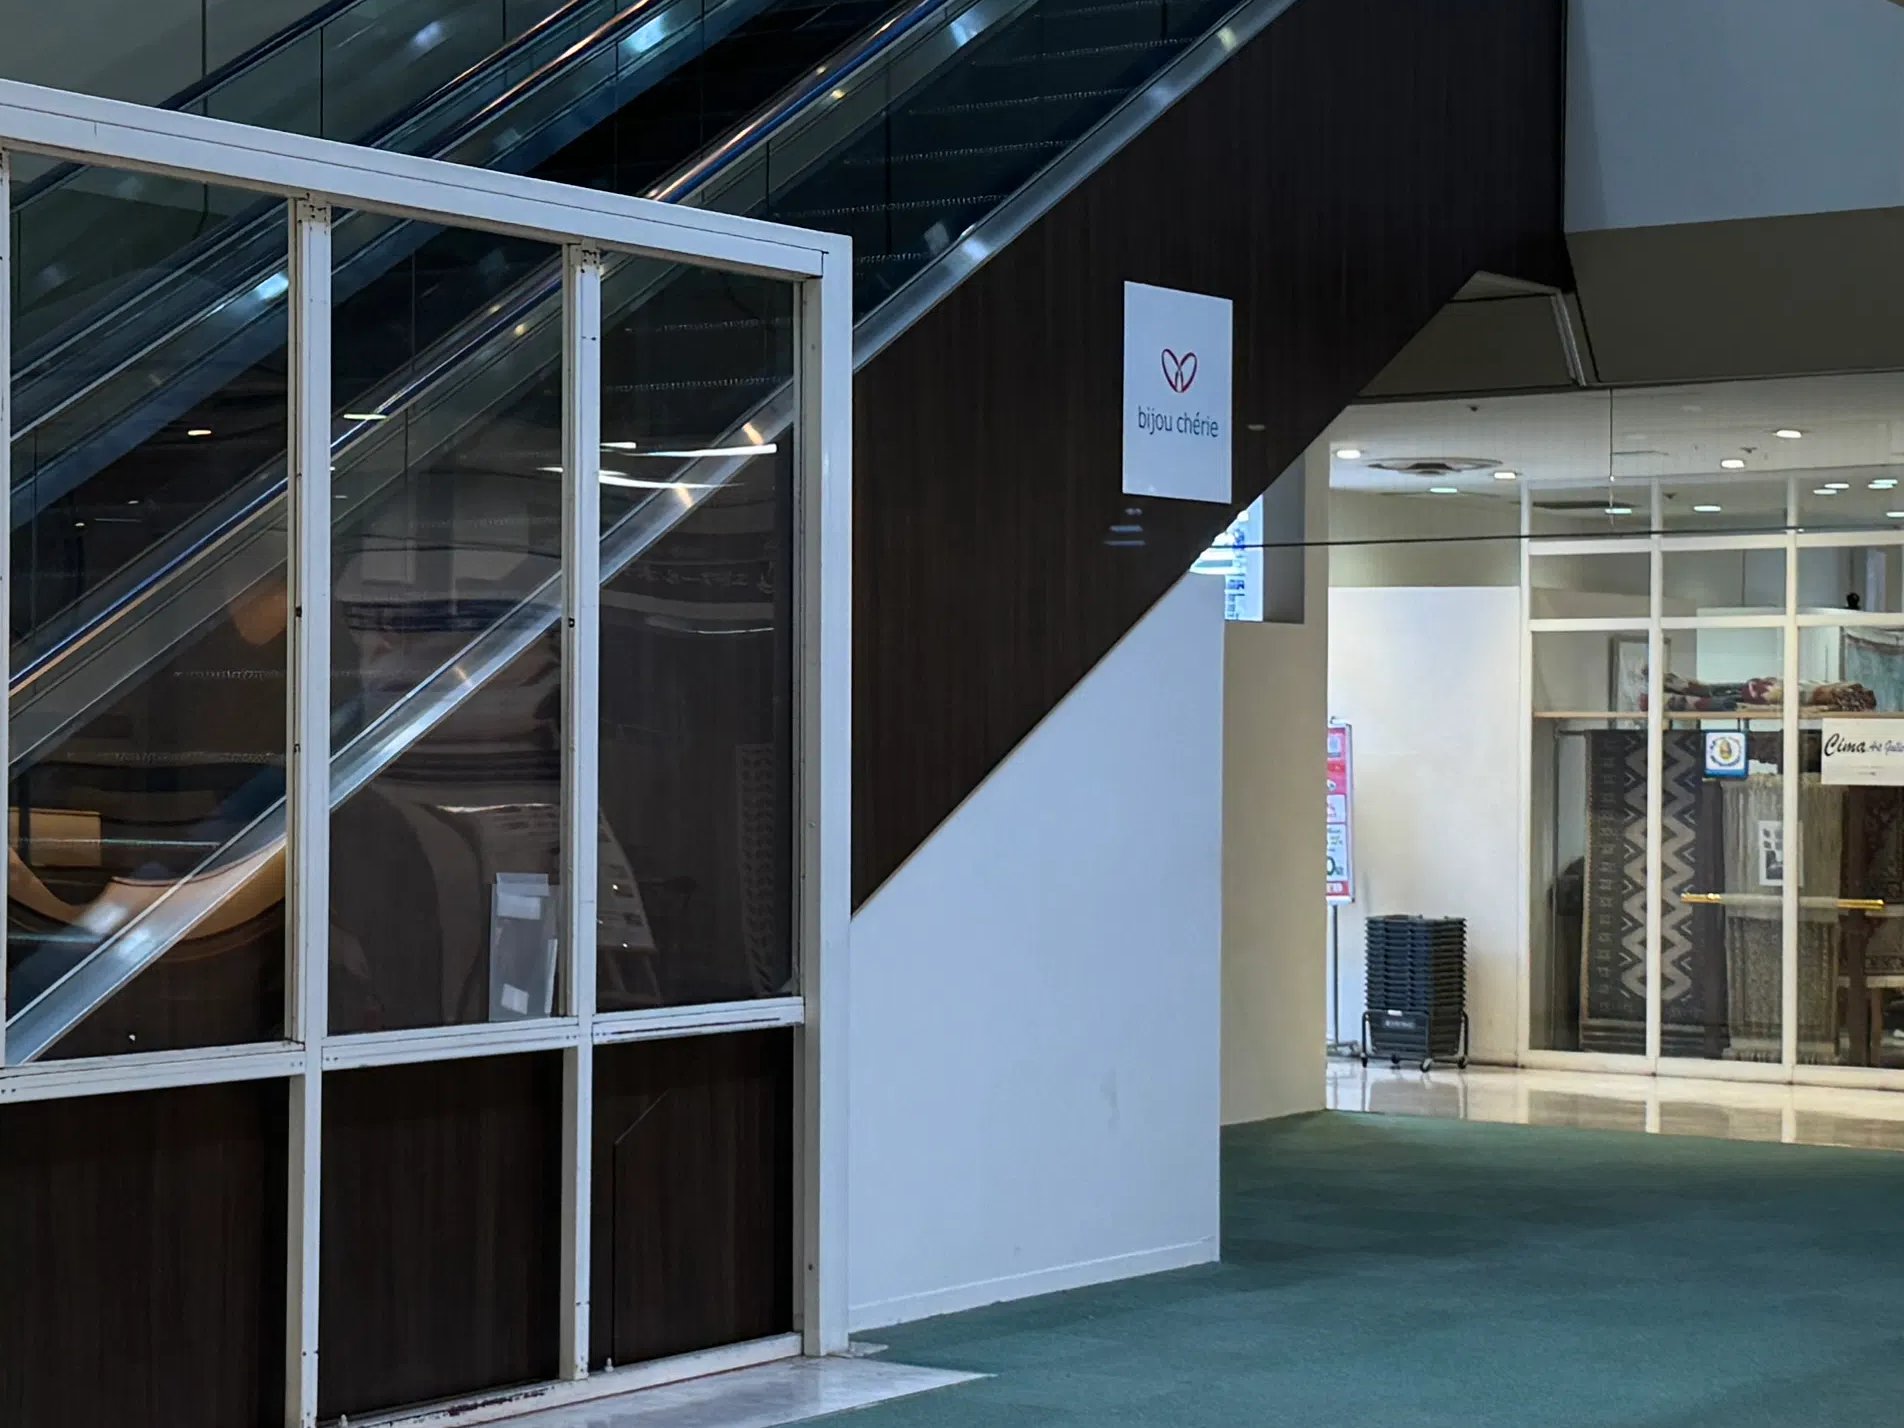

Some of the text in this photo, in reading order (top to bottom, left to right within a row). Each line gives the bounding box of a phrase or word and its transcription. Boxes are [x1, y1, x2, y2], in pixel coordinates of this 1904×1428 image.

[1138, 405, 1220, 439] bijou chérie
[1824, 732, 1867, 757] Cima
